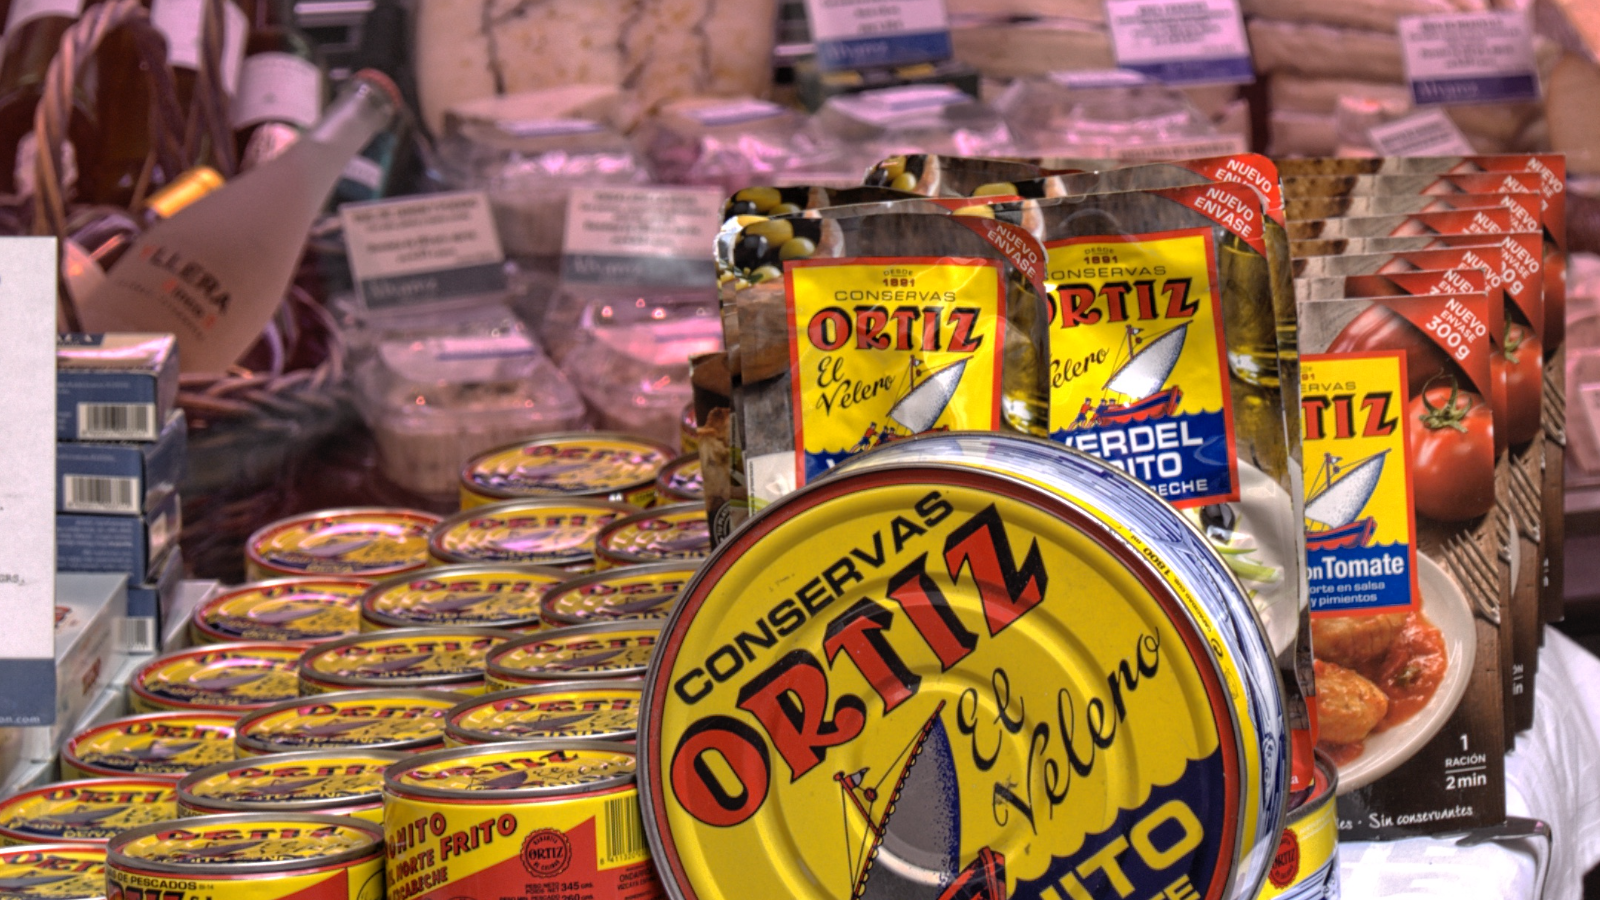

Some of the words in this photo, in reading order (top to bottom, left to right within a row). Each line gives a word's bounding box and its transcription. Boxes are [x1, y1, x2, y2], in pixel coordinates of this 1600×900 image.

[1226, 159, 1272, 193] NUEVO
[1525, 157, 1563, 193] NUEVO
[1193, 196, 1252, 238] ENVASE
[1205, 187, 1254, 222] NUEVO
[1501, 195, 1538, 232] NUEVO
[987, 230, 1036, 278] ENVASE
[996, 225, 1038, 264] NUEVO
[1502, 236, 1540, 273] NUEVO
[883, 268, 914, 277] DESDE
[1050, 266, 1167, 281] ONSERVAS
[1501, 248, 1531, 279] NVASE
[834, 290, 957, 302] CONSERVAS
[807, 304, 985, 353] ORTIZ
[1440, 310, 1477, 344] ENVASE
[1445, 298, 1487, 337] NUEVO
[816, 356, 845, 388] El
[1050, 347, 1110, 389] elero
[816, 374, 896, 416] Velero
[1302, 391, 1399, 441] TIZ
[1143, 547, 1171, 577] 1800
[1322, 555, 1405, 579] Tomate
[674, 490, 956, 707] CONSERVAS
[1309, 583, 1335, 595] orte
[1337, 582, 1352, 593] en
[1354, 580, 1386, 592] salsa
[1318, 594, 1378, 607] pimientos
[670, 503, 1050, 828] ORTIZ
[957, 667, 1025, 772] El
[993, 627, 1163, 835] Velero
[1460, 734, 1469, 751] 1
[1445, 752, 1487, 768] RACIÓN
[1445, 776, 1456, 790] 2
[1457, 772, 1487, 789] min
[1368, 812, 1394, 829] Sin
[1396, 805, 1474, 826] conservantes
[440, 813, 518, 861] FRITO
[528, 846, 564, 860] ORTIZ
[130, 875, 198, 891] PESCADOS
[561, 882, 580, 891] 345
